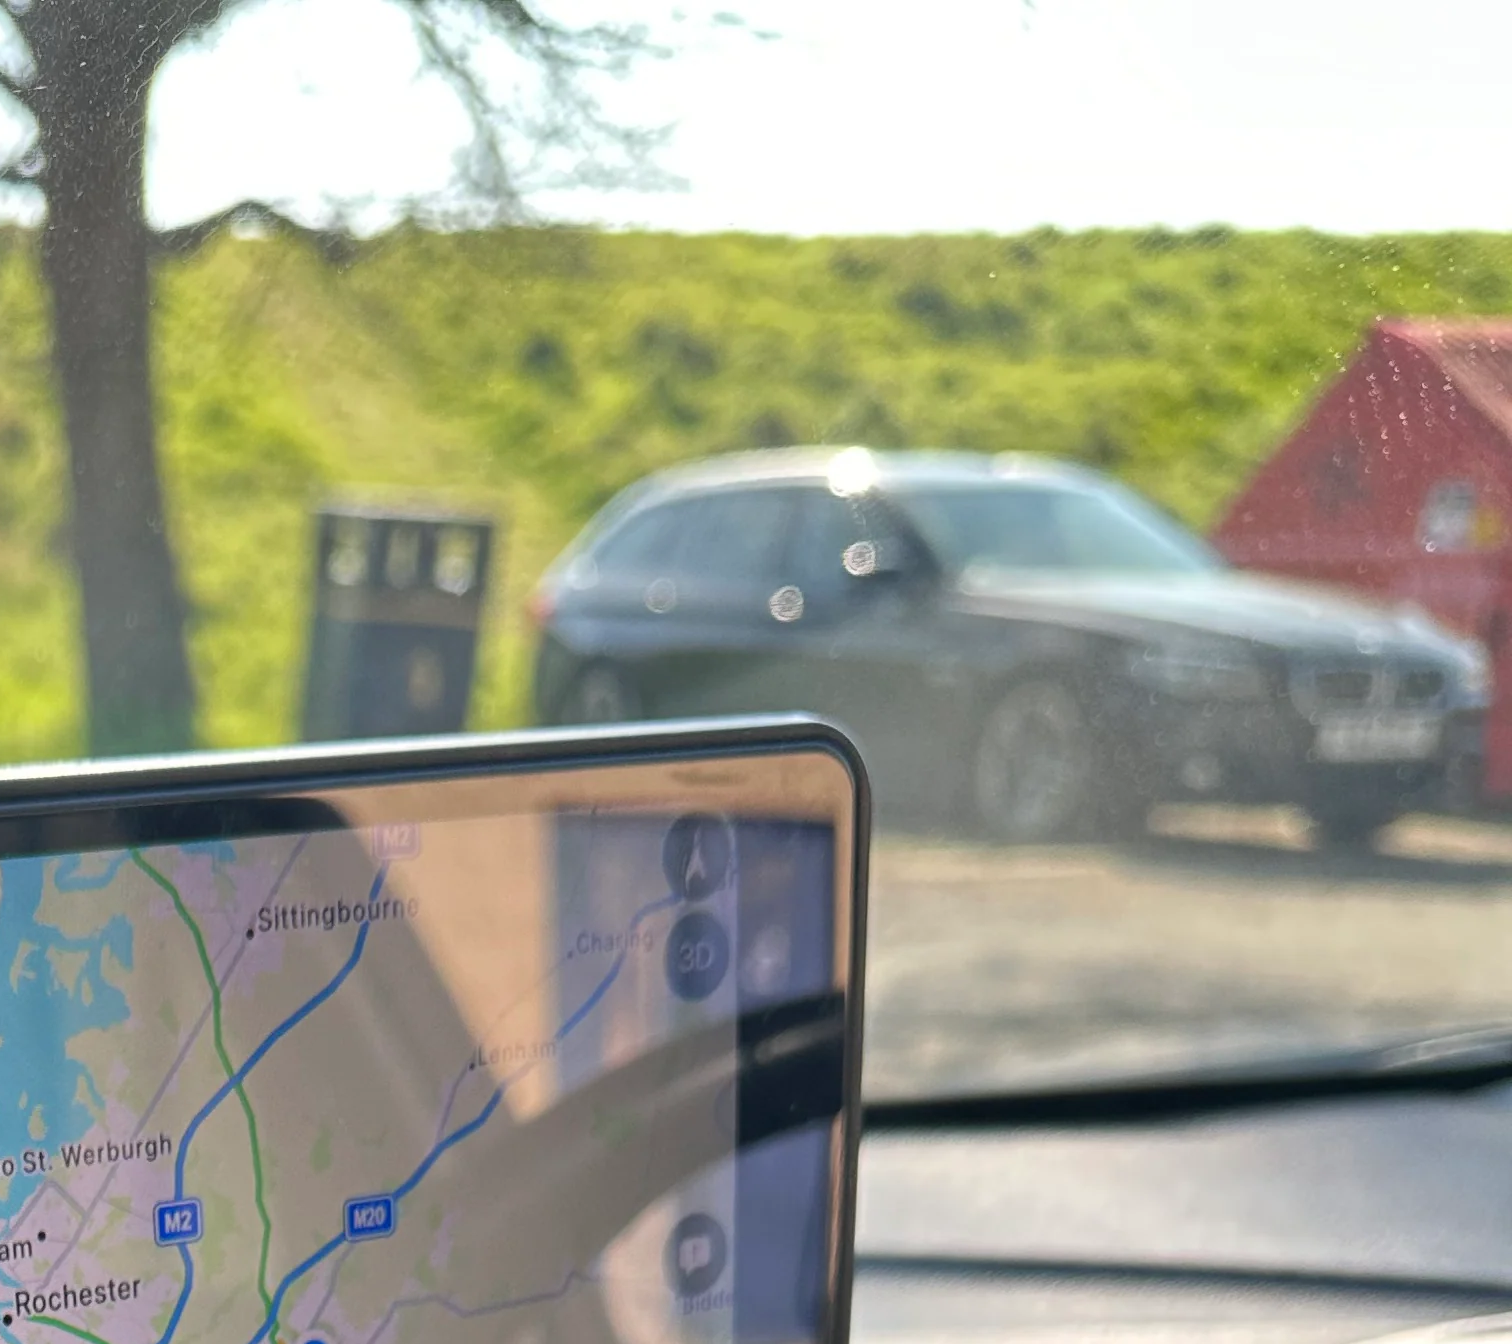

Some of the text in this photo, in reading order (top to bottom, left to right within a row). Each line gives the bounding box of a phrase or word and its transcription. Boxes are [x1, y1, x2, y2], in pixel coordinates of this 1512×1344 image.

[258, 895, 419, 933] Sittingbourne
[678, 941, 713, 974] 3D
[23, 1149, 53, 1173] St.
[61, 1132, 173, 1168] Werburgh
[164, 1210, 193, 1233] M2
[354, 1205, 386, 1230] M20
[14, 1278, 141, 1317] Rochester
